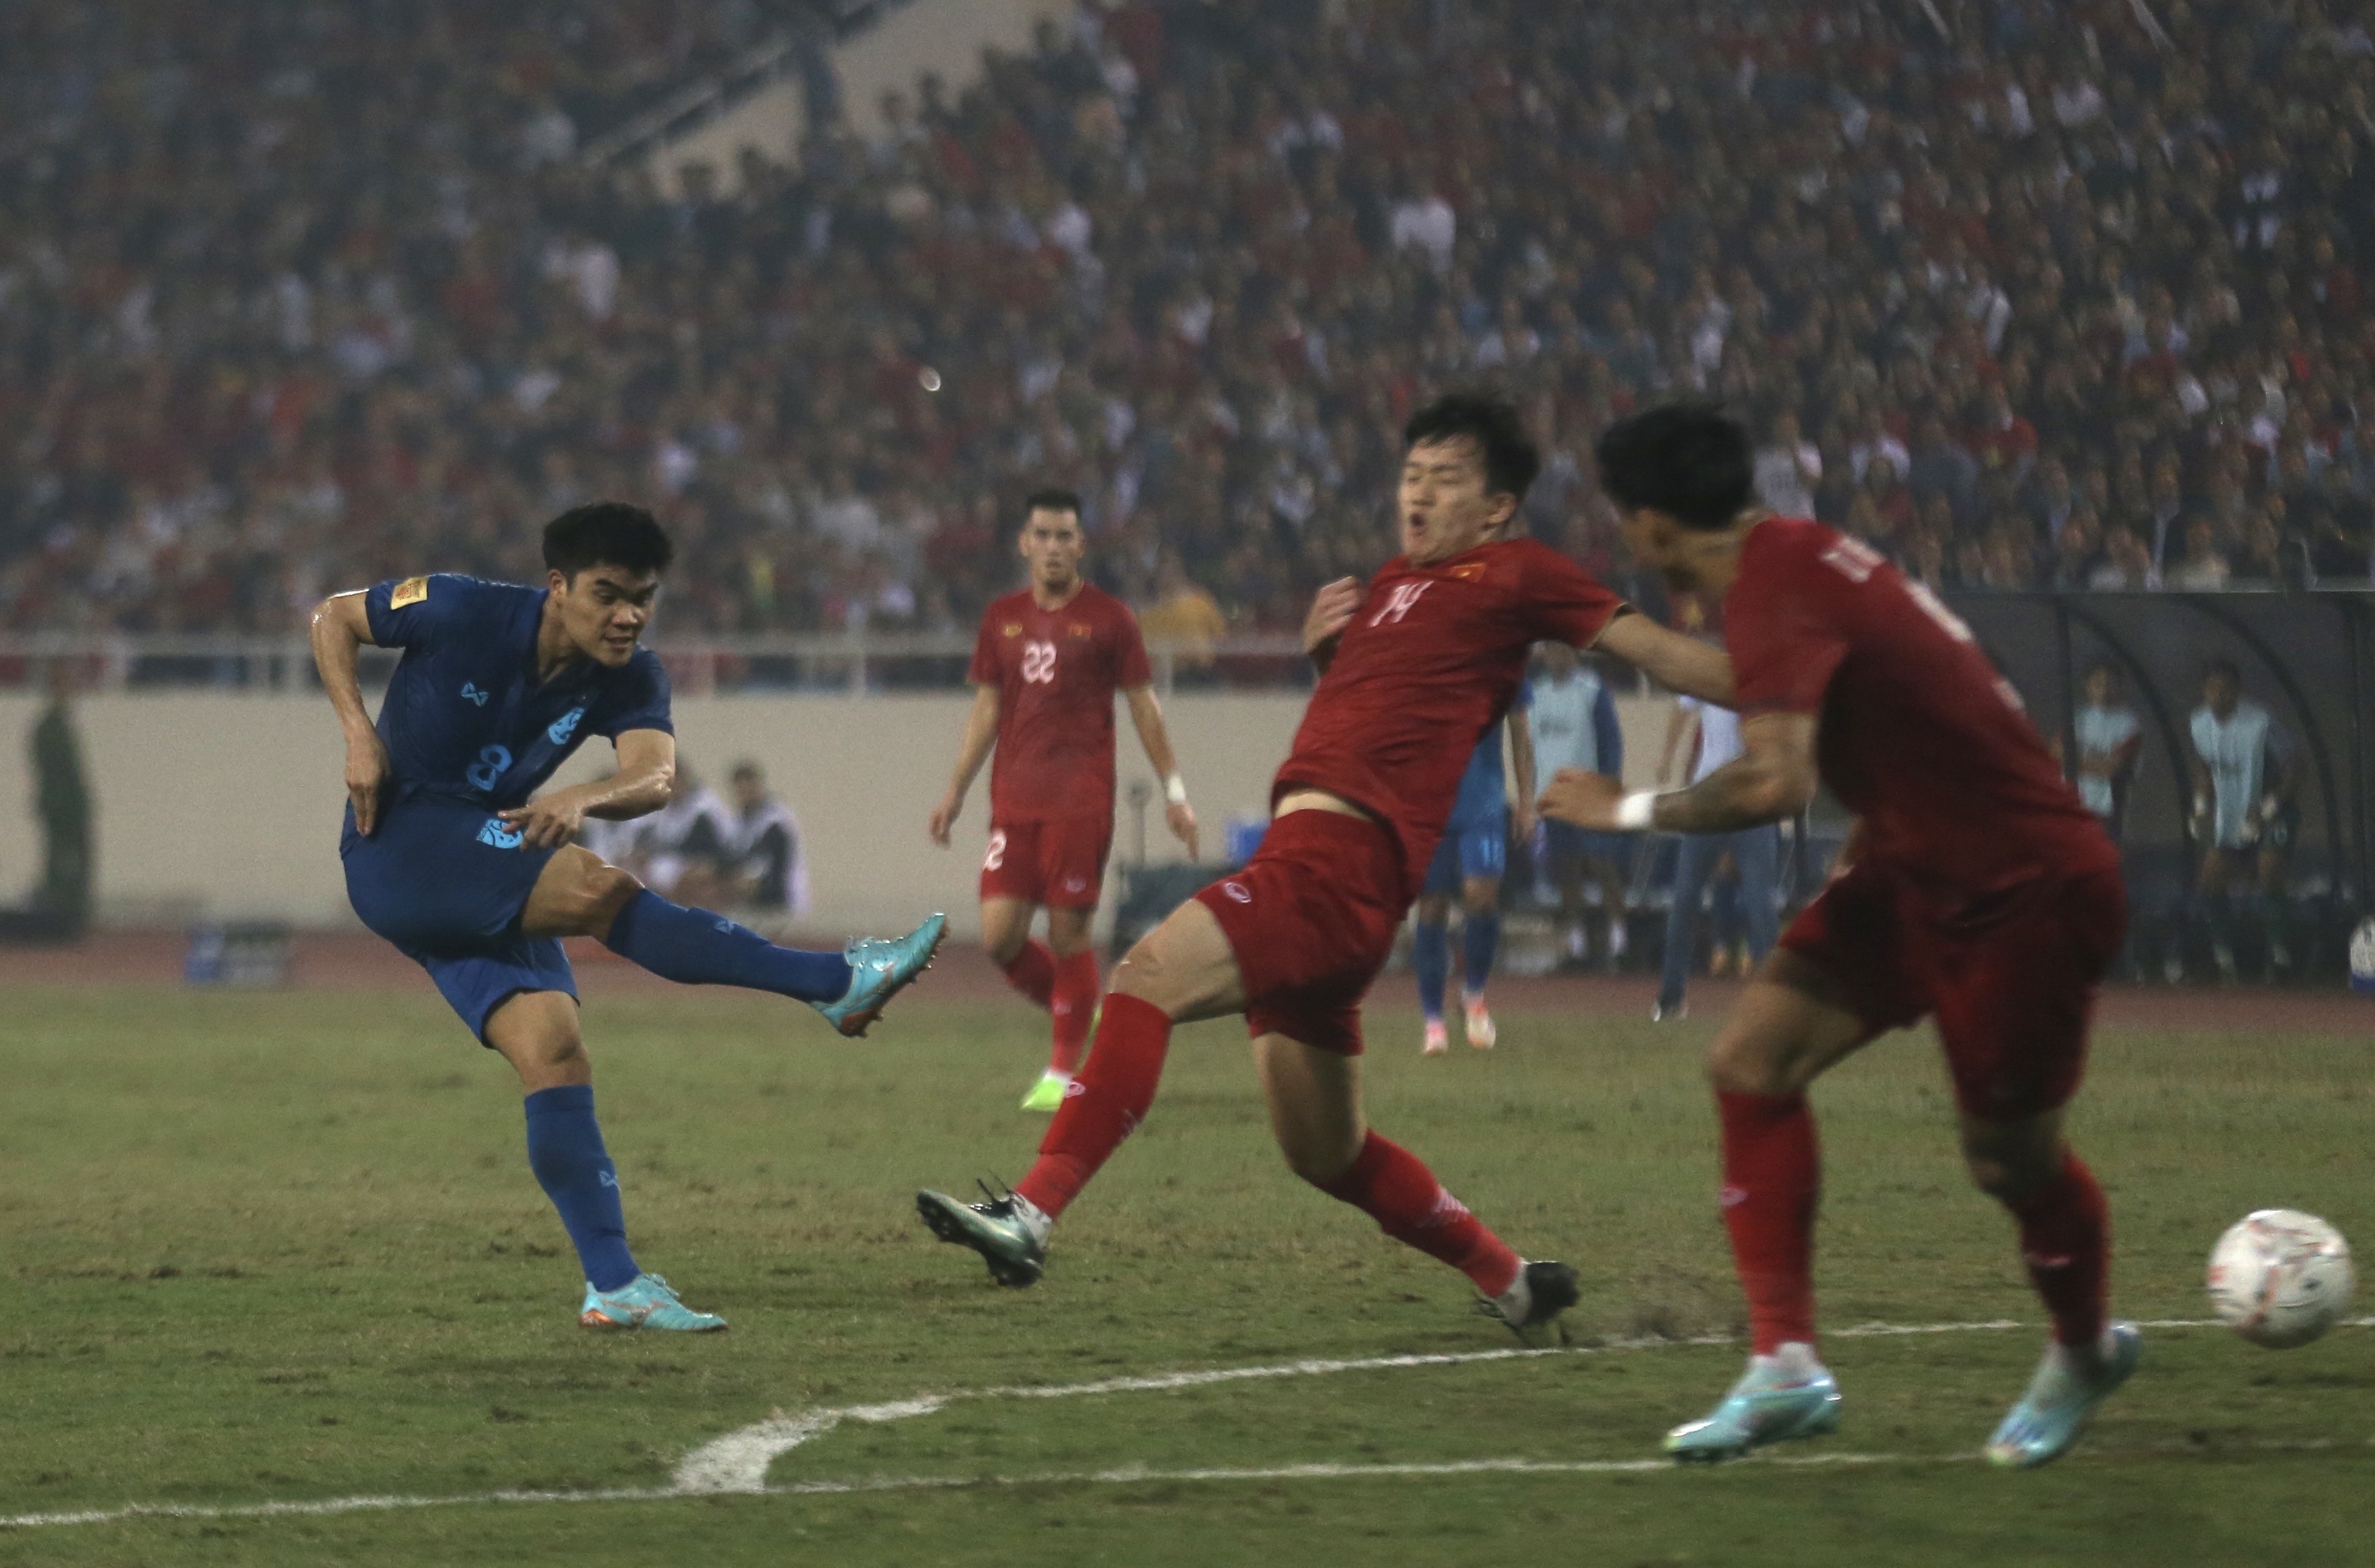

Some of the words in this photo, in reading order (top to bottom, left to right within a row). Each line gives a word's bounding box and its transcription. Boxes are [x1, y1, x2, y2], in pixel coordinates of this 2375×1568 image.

[1369, 580, 1434, 627] 14
[1024, 641, 1057, 684] 22
[467, 744, 512, 792] 8
